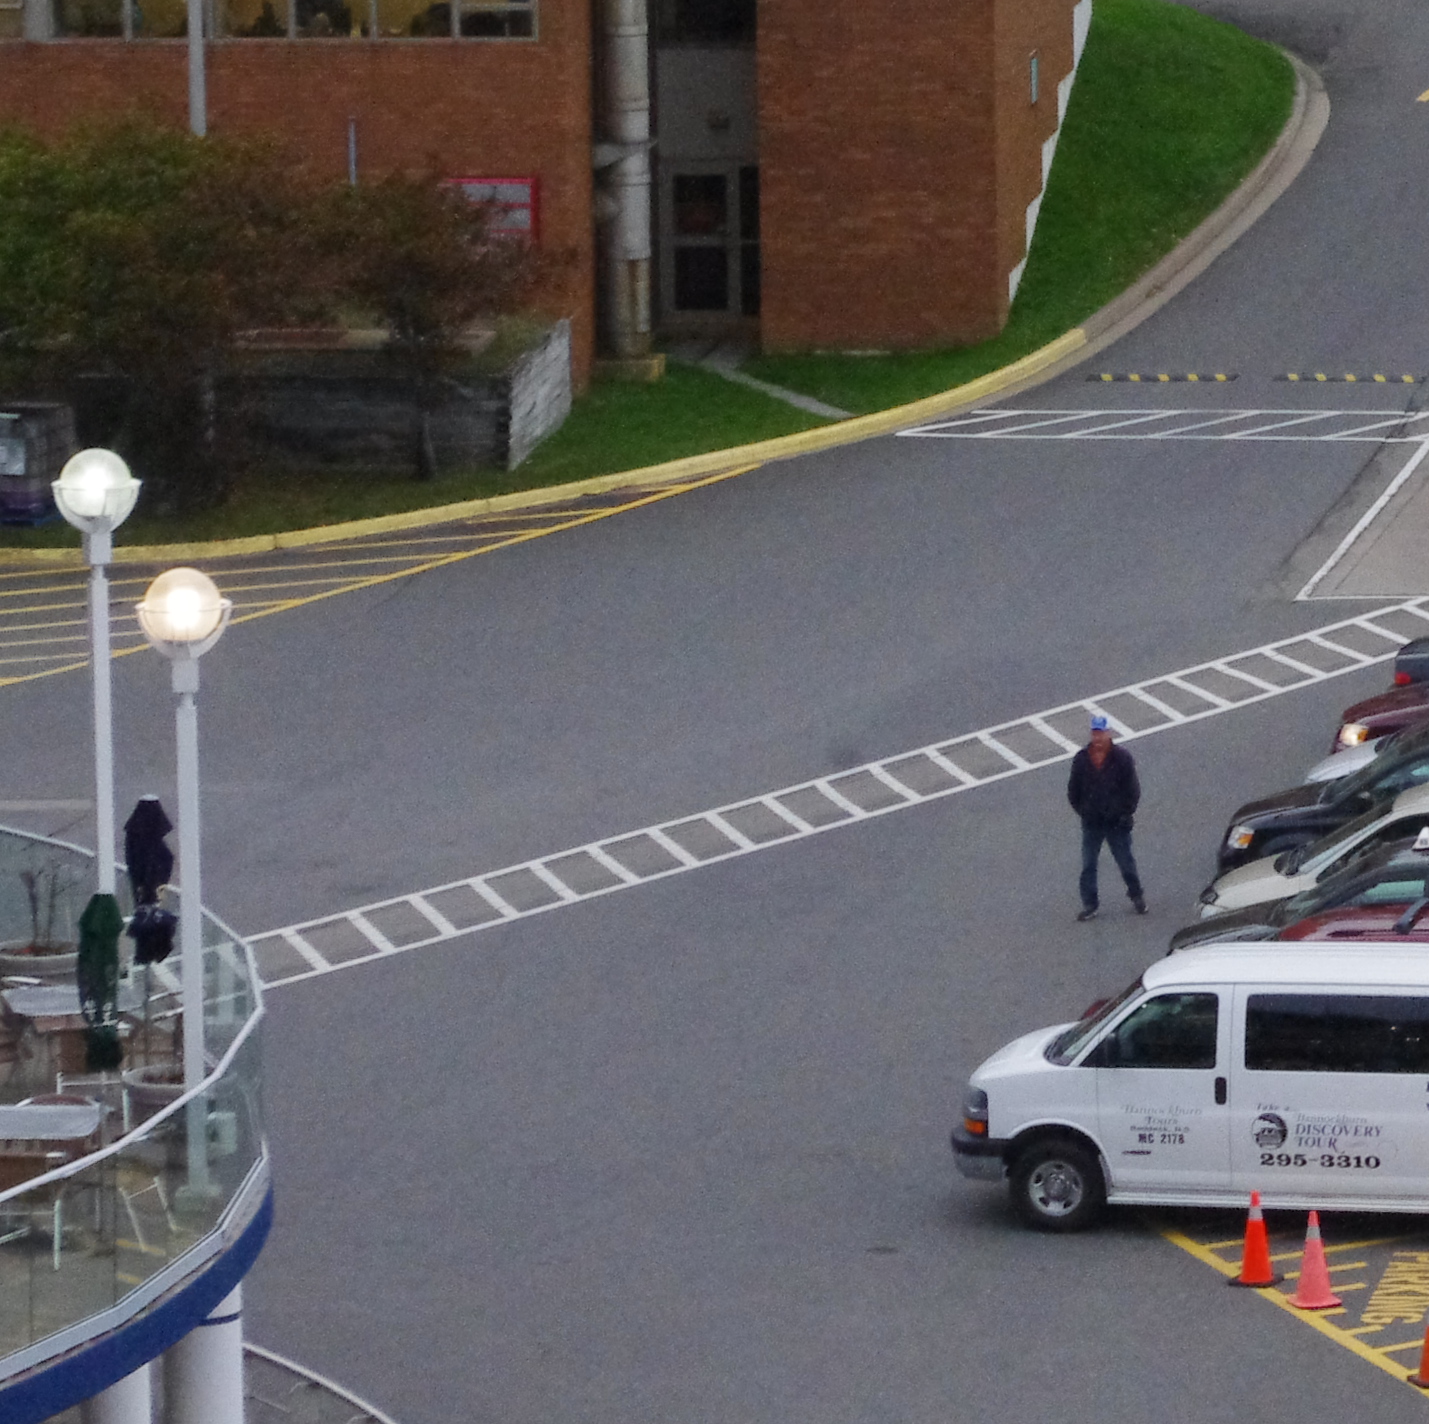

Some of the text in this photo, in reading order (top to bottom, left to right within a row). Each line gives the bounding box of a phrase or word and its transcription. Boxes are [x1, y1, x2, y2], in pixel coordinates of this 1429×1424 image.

[1160, 1132, 1185, 1145] 2178
[1295, 1123, 1384, 1138] DISCOVERY
[1297, 1136, 1338, 1153] TOUR
[1259, 1152, 1381, 1170] 295-3310
